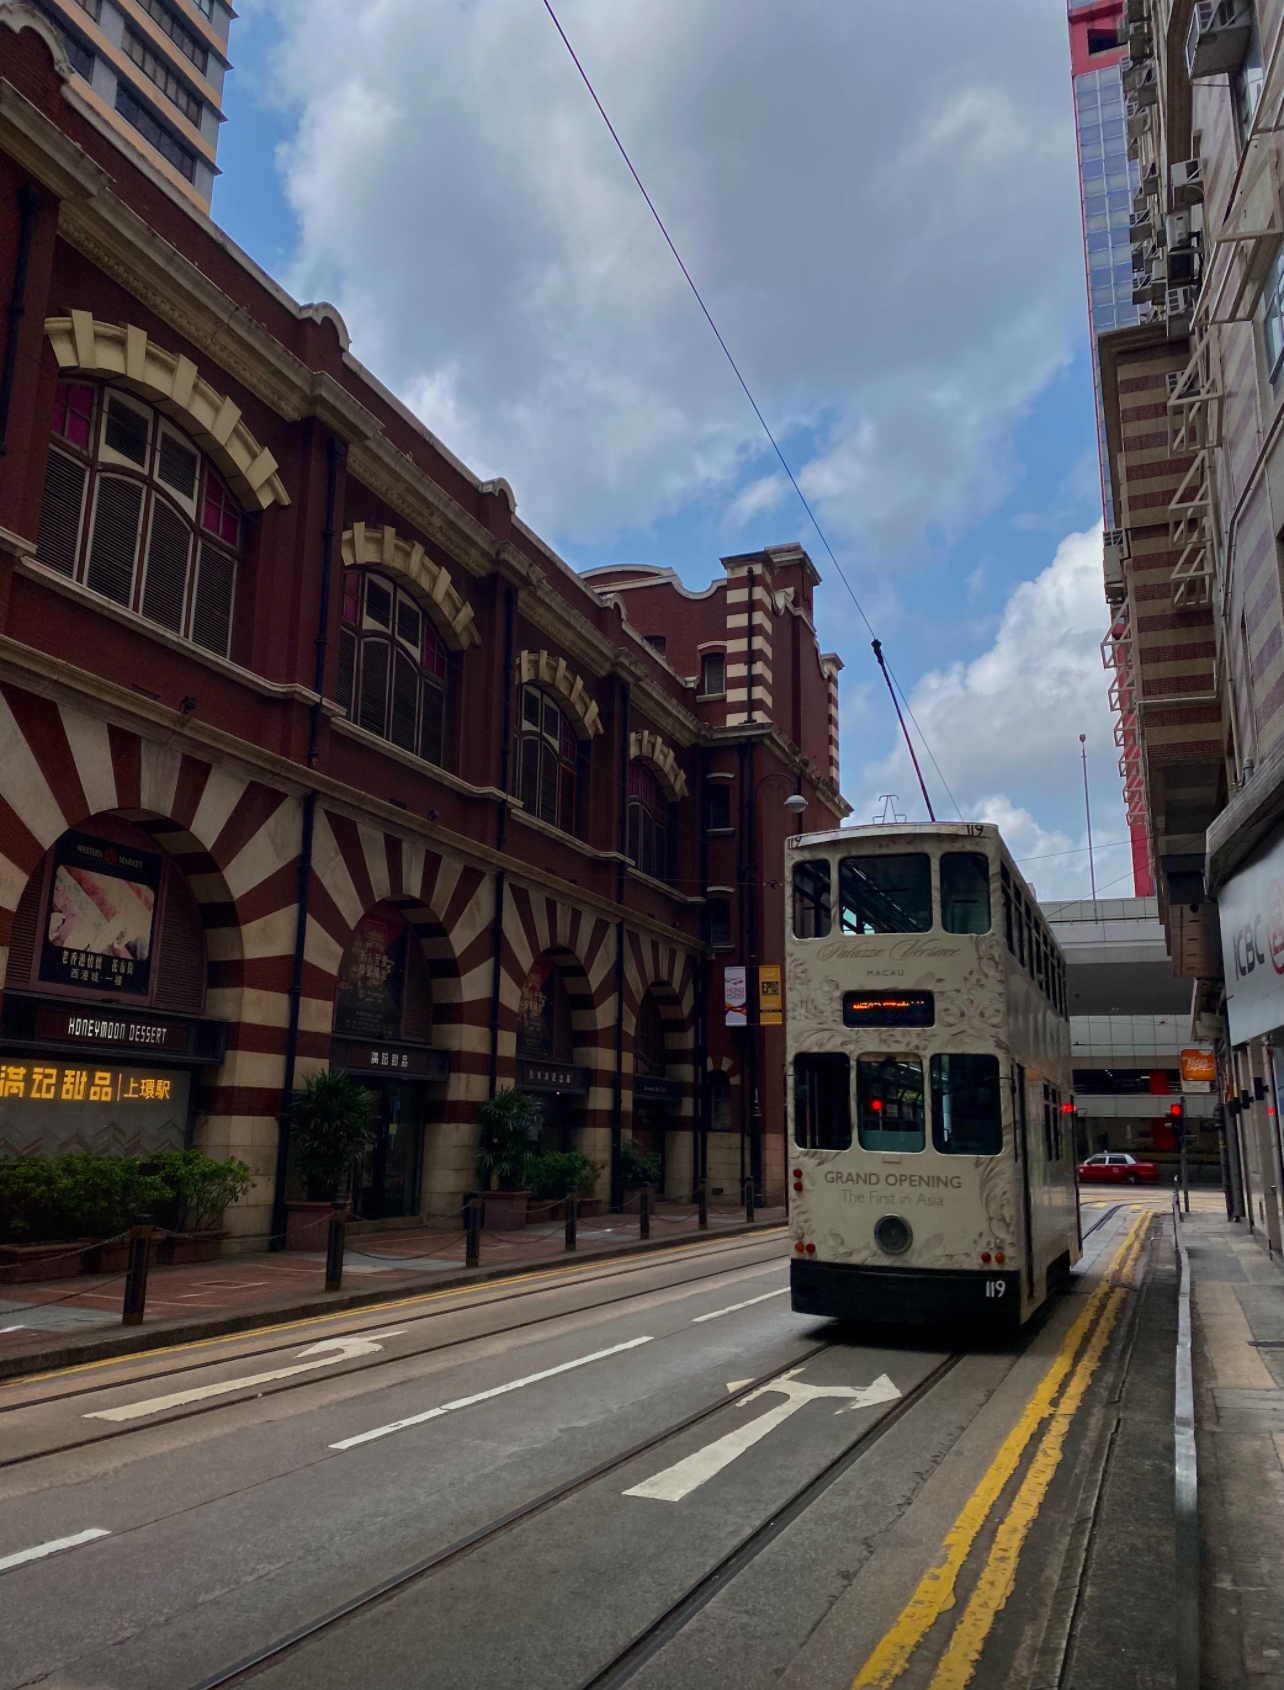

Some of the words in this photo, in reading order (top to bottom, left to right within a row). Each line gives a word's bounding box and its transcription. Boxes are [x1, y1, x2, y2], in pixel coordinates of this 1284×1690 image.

[966, 824, 984, 837] 119
[77, 844, 103, 859] WESTERN
[118, 855, 143, 869] MARKET
[1233, 914, 1265, 981] ICBC
[866, 969, 905, 977] MACAU
[67, 1017, 126, 1041] HONEYMOON
[129, 1024, 168, 1044] DESSERT
[824, 1170, 880, 1186] GRAND
[885, 1173, 962, 1189] OPENING
[840, 1189, 865, 1203] The
[869, 1190, 896, 1205] First
[899, 1191, 912, 1205] in
[915, 1193, 944, 1207] Asia
[985, 1280, 1006, 1298] 119
